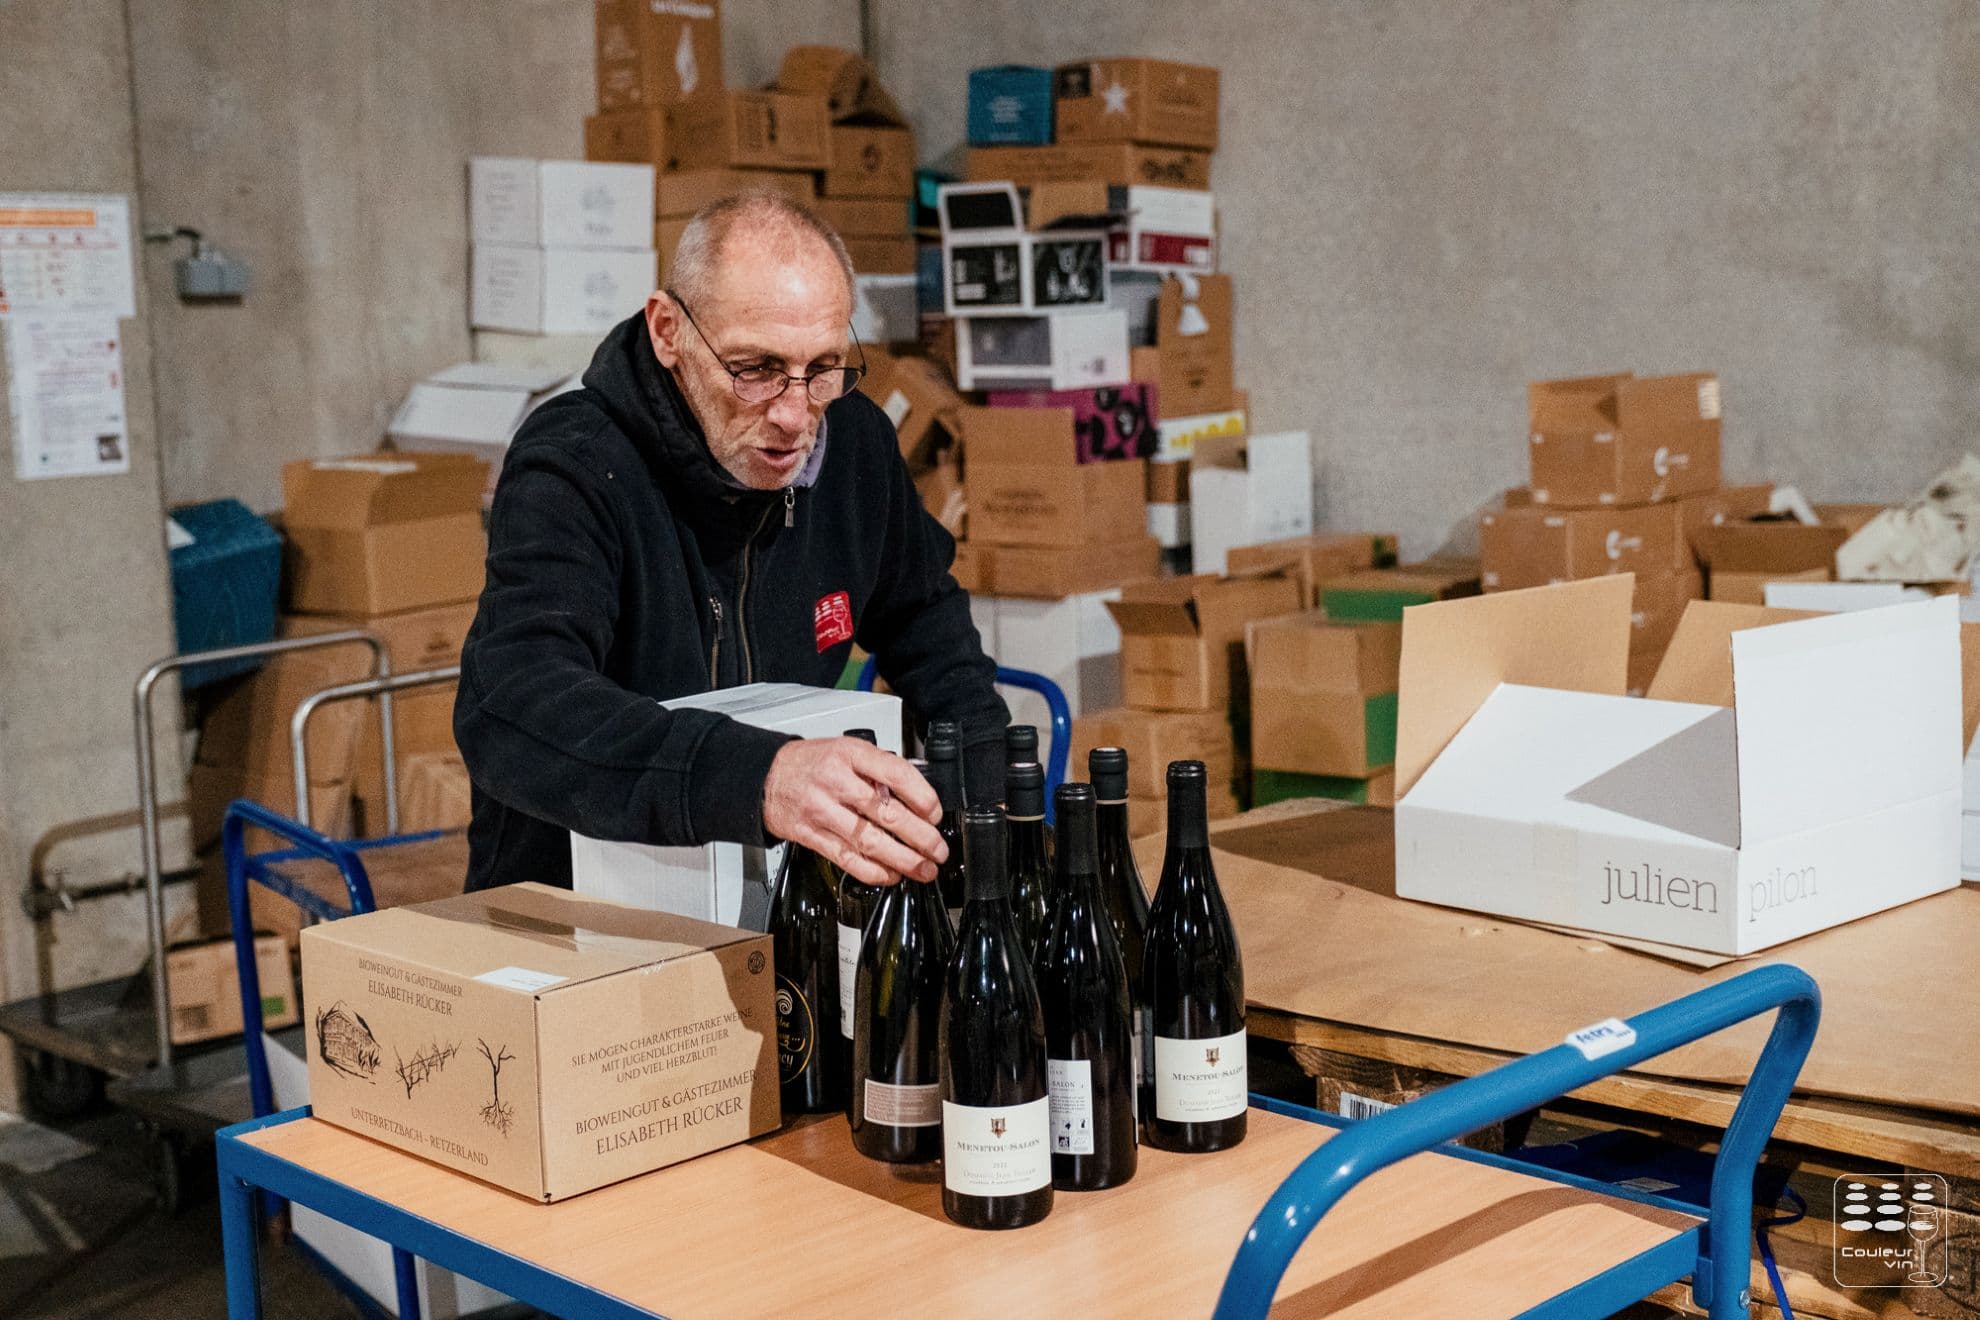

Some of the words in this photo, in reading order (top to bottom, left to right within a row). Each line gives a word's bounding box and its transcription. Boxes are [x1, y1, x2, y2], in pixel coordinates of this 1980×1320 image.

[1601, 861, 1717, 913] julien
[1749, 866, 1818, 922] pilon
[358, 957, 404, 981] BIOWEINGUT
[368, 980, 413, 1005] ELISABETH
[572, 1053, 587, 1068] SIE
[629, 1016, 722, 1051] CHARAKTERSTARKE
[723, 1008, 753, 1024] WEINE
[601, 1059, 621, 1074] MIT
[622, 1038, 699, 1069] JUGENDLICHEM
[701, 1028, 729, 1045] FEUER
[616, 1068, 641, 1083] UND
[643, 1061, 664, 1076] VIEL
[576, 1098, 660, 1135] BIOWEINGUT
[661, 1095, 671, 1109] &
[673, 1069, 758, 1105] GÄSTEZIMMER
[595, 1116, 678, 1155] ELISABETH
[683, 1096, 743, 1128] RÜCKER
[351, 1106, 423, 1143] UNTERRETZBACH
[430, 1135, 489, 1166] RETZERLAND
